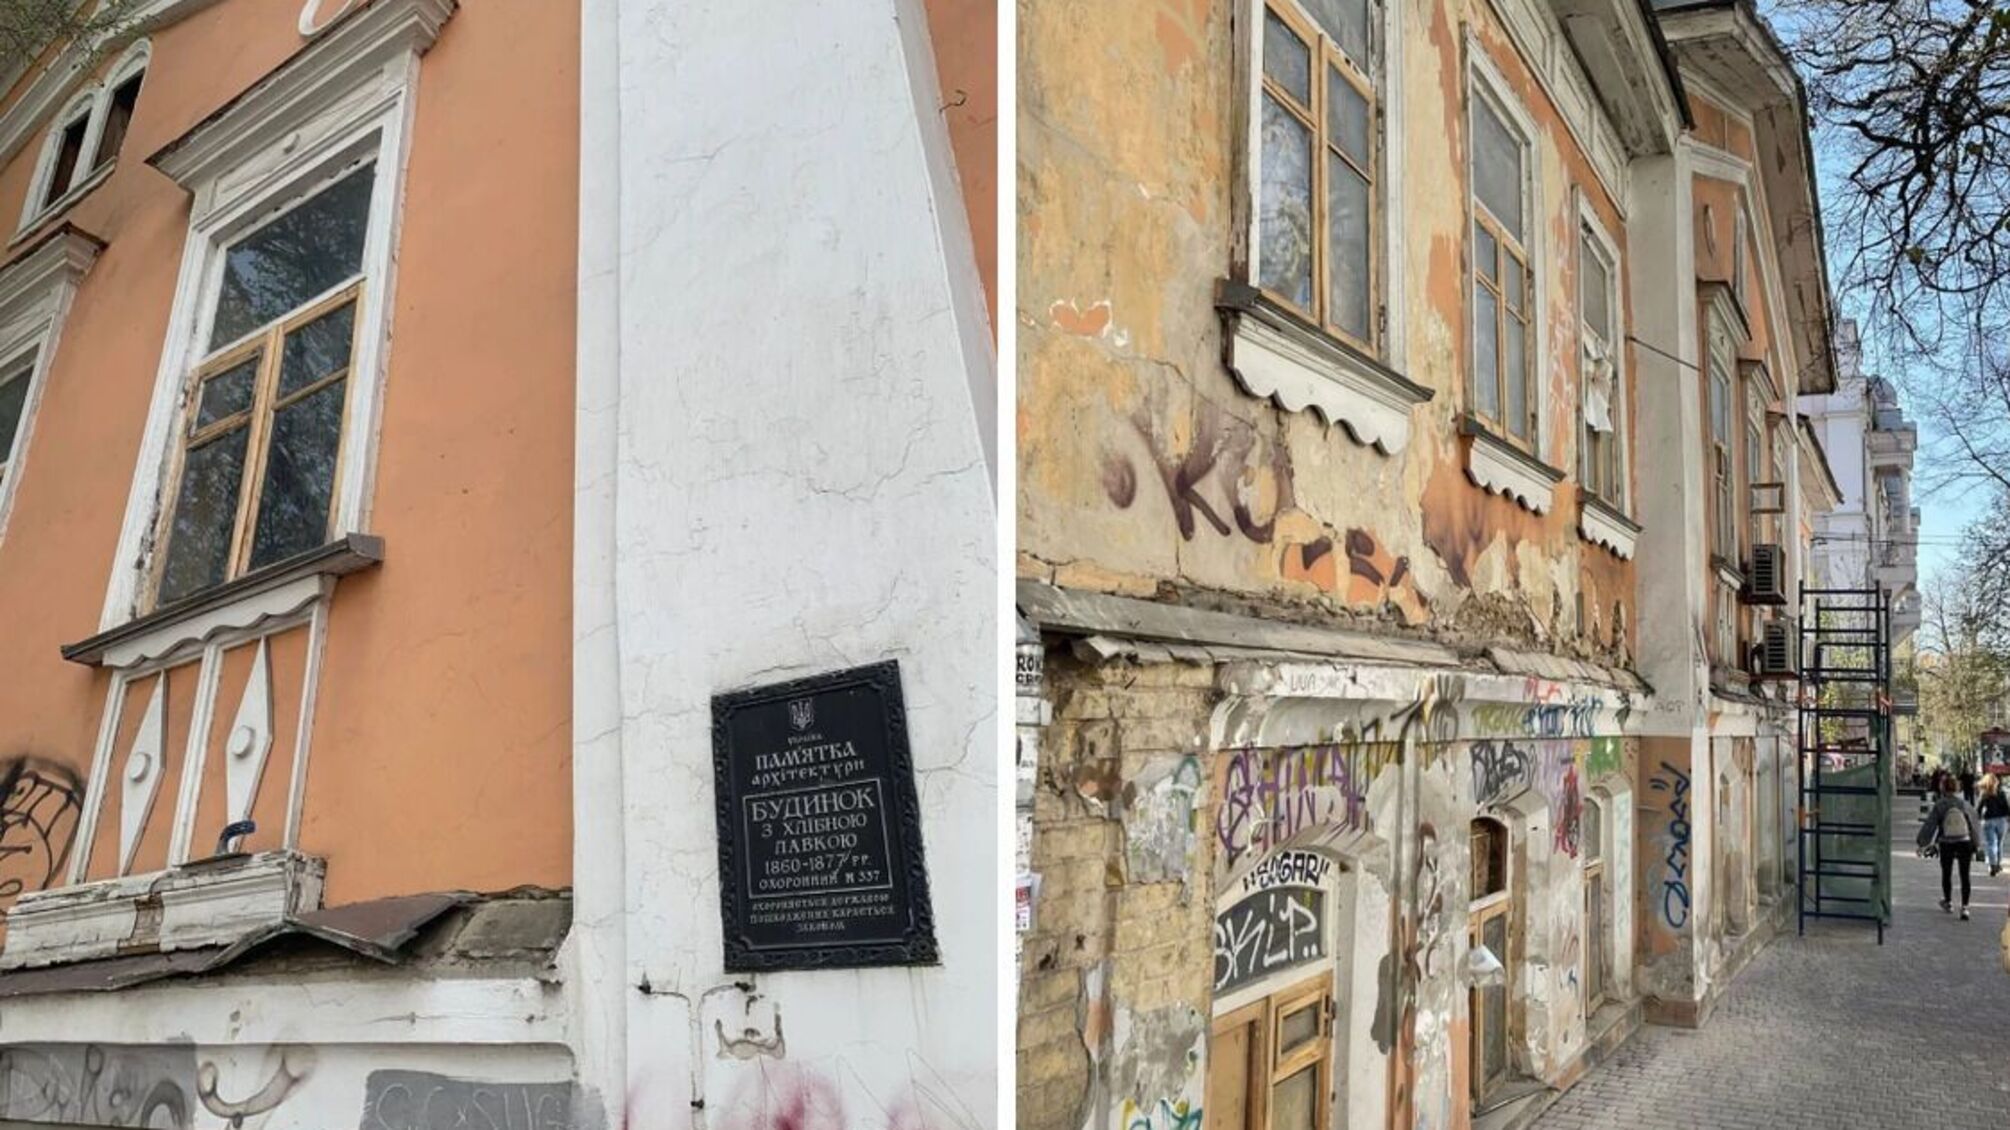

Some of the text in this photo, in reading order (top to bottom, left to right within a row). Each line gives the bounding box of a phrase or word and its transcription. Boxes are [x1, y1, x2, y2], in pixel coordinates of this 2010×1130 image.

[752, 787, 875, 822] БУДИНОК
[761, 812, 868, 838] З ХЛІБНОЮ
[775, 833, 858, 855] ЛАВКОЮ
